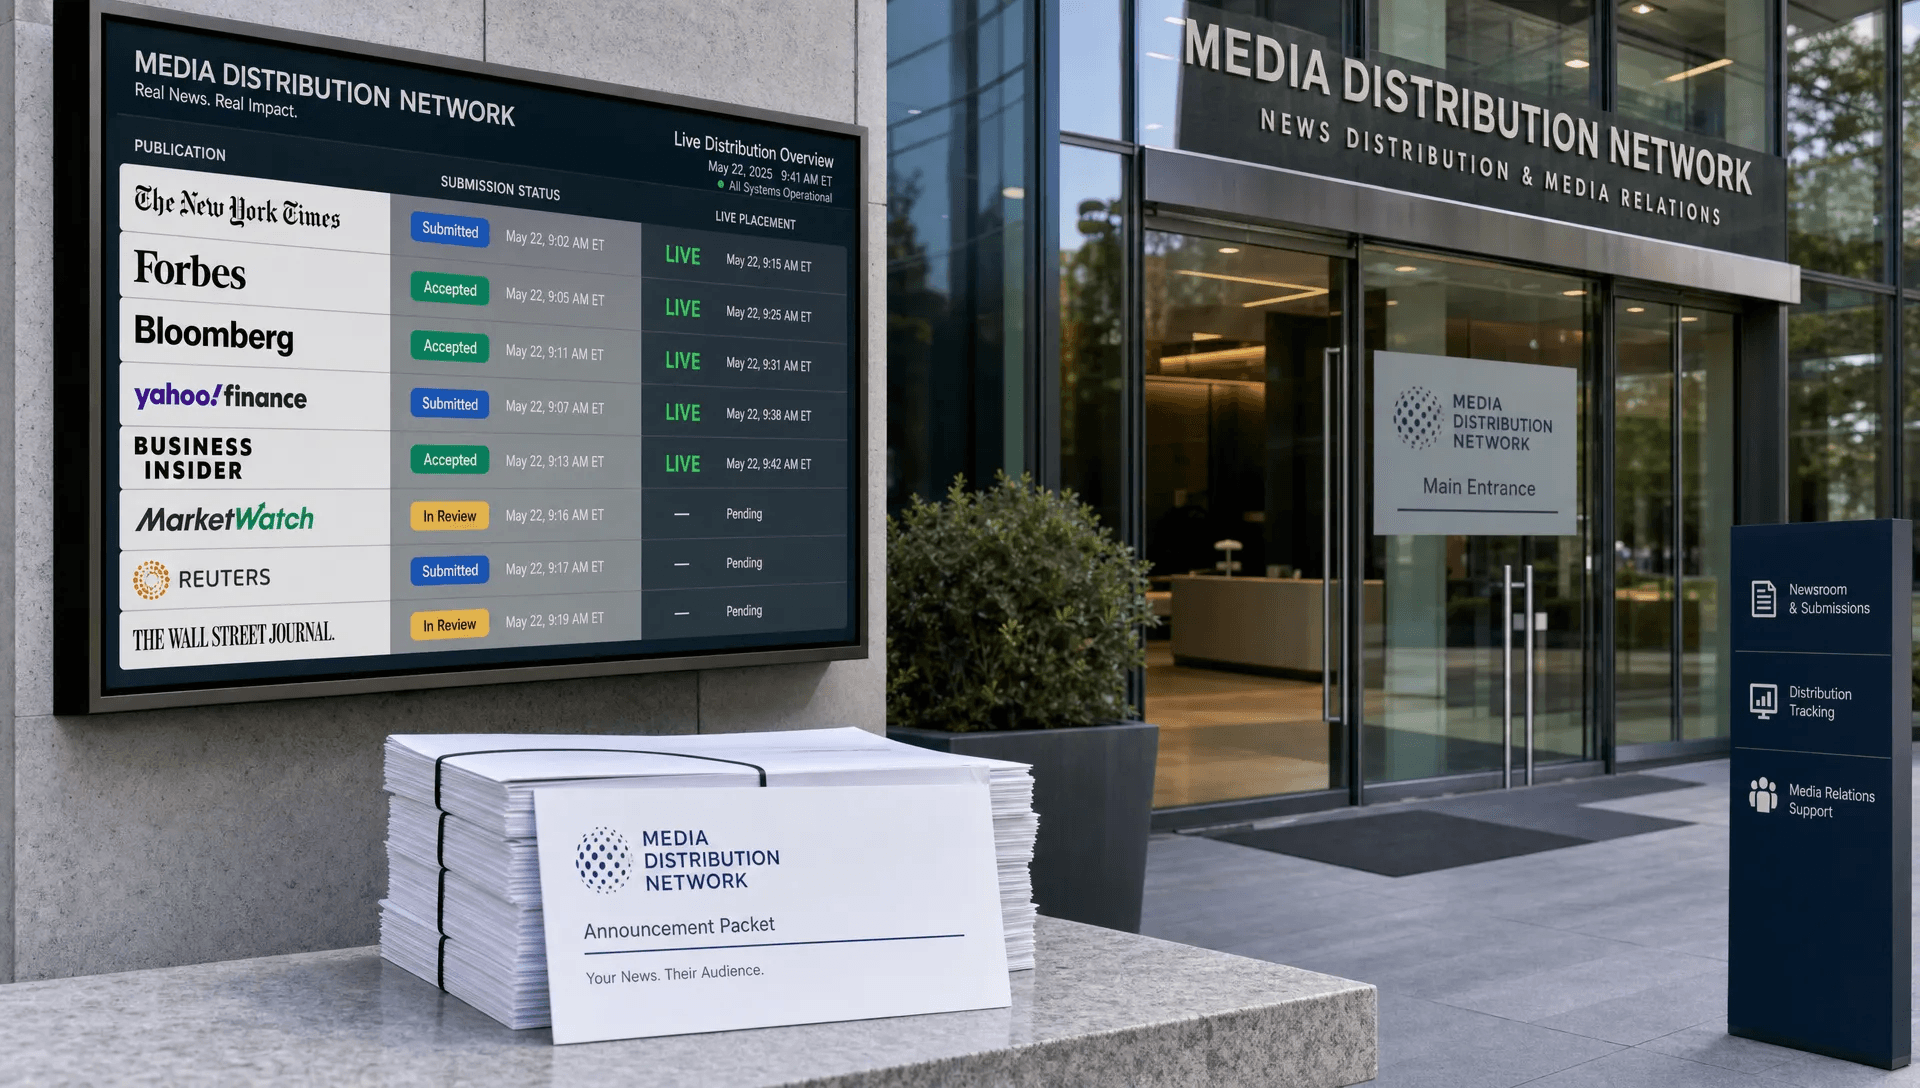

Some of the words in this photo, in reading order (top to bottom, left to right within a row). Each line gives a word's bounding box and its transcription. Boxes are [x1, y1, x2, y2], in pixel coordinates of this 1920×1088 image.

[136, 50, 216, 83] MEDIA
[224, 63, 389, 108] DISTRIBUTION
[401, 90, 515, 126] NETWORK
[136, 82, 164, 99] Real
[170, 87, 210, 105] News.
[216, 94, 243, 110] Real
[249, 98, 297, 118] Impact.
[1184, 17, 1330, 95] MEDIA
[1345, 56, 1598, 158] DISTRIBUTION
[1611, 126, 1752, 195] NETWORK
[135, 139, 225, 161] PUBLICATION
[675, 131, 700, 149] Live
[706, 136, 776, 160] Distribution
[780, 148, 833, 168] Overview
[709, 160, 728, 176] May
[732, 163, 745, 177] 22,
[750, 166, 772, 179] 2025
[781, 170, 799, 182] 9:41
[804, 173, 818, 185] AM
[822, 175, 832, 186] ET
[1262, 108, 1329, 142] NEWS
[1348, 127, 1507, 180] DISTRIBUTION
[1523, 166, 1532, 185] &
[1546, 171, 1609, 202] MEDIA
[1622, 188, 1719, 225] RELATIONS
[441, 176, 513, 195] SUBMISSION
[519, 185, 560, 200] STATUS
[729, 181, 740, 191] All
[744, 182, 780, 196] Systems
[783, 188, 832, 202] Operational
[135, 185, 174, 216] The
[180, 190, 224, 217] New
[229, 196, 278, 224] York
[283, 201, 340, 228] Times
[716, 211, 736, 223] LIVE
[740, 214, 796, 229] PLACEMENT
[422, 221, 479, 240] Submitted
[507, 230, 527, 246] May
[531, 232, 545, 246] 22,
[549, 234, 569, 247] 9:02
[573, 237, 588, 249] AM
[593, 239, 604, 251] ET
[666, 245, 701, 265] LIVE
[727, 254, 745, 268] May
[748, 256, 760, 269] 22,
[763, 257, 781, 269] 9:15
[784, 260, 798, 271] AM
[801, 261, 811, 272] ET
[134, 250, 246, 289] Forbes
[424, 281, 477, 299] Accepted
[507, 287, 527, 303] May
[530, 289, 544, 303] 22,
[549, 291, 569, 303] 9:05
[573, 293, 588, 305] AM
[593, 294, 604, 306] ET
[666, 298, 700, 317] LIVE
[727, 306, 745, 320] May
[748, 307, 760, 320] 22,
[763, 308, 781, 320] 9:25
[784, 310, 798, 321] AM
[801, 311, 811, 322] ET
[135, 315, 293, 357] Bloomberg
[424, 339, 477, 357] Accepted
[507, 344, 527, 359] May
[531, 345, 544, 359] 22,
[549, 346, 567, 358] 9:11
[572, 348, 587, 359] AM
[592, 349, 604, 360] ET
[666, 351, 700, 369] LIVE
[727, 357, 745, 371] May
[748, 358, 760, 371] 22,
[763, 359, 780, 370] 9:31
[784, 360, 798, 371] AM
[801, 361, 811, 372] ET
[422, 397, 478, 410] Submitted
[507, 400, 527, 415] May
[531, 401, 545, 414] 22,
[549, 401, 569, 413] 9:07
[572, 402, 588, 413] AM
[592, 403, 604, 414] ET
[1454, 394, 1502, 411] MEDIA
[666, 403, 700, 421] LIVE
[727, 408, 744, 422] May
[748, 409, 760, 421] 22,
[763, 409, 781, 420] 9:38
[784, 410, 798, 420] AM
[801, 410, 811, 421] ET
[1454, 414, 1552, 433] DISTRIBUTION
[135, 437, 251, 456] BUSINESS
[1454, 434, 1529, 450] NETWORK
[146, 461, 241, 479] INSIDER
[424, 453, 476, 469] Accepted
[507, 455, 527, 470] May
[530, 455, 545, 468] 22,
[549, 455, 568, 467] 9:13
[572, 456, 588, 467] AM
[592, 456, 604, 467] ET
[666, 455, 700, 472] LIVE
[727, 458, 745, 471] May
[748, 458, 760, 470] 22,
[763, 458, 781, 469] 9:42
[784, 459, 798, 469] AM
[801, 459, 811, 469] ET
[1424, 478, 1461, 494] Main
[1468, 479, 1535, 496] Entrance
[135, 502, 313, 531] MarketWatch
[424, 510, 433, 522] In
[438, 510, 476, 521] Review
[507, 510, 527, 524] May
[530, 509, 545, 523] 22,
[548, 509, 568, 520] 9:16
[572, 509, 588, 520] AM
[592, 509, 604, 520] ET
[727, 508, 762, 521] Pending
[423, 563, 478, 577] Submitted
[507, 563, 527, 577] May
[531, 562, 545, 575] 22,
[549, 562, 568, 573] 9:17
[572, 561, 588, 573] AM
[592, 561, 604, 572] ET
[727, 557, 762, 570] Pending
[180, 569, 270, 588] REUTERS
[1790, 584, 1847, 595] Newsroom
[727, 605, 762, 618] Pending
[1790, 602, 1797, 614] &
[1802, 602, 1870, 614] Submissions
[424, 620, 433, 632] In
[438, 619, 476, 631] Review
[506, 616, 527, 630] May
[530, 615, 545, 628] 22,
[549, 614, 569, 625] 9:19
[572, 613, 588, 624] AM
[592, 612, 604, 623] ET
[133, 629, 164, 650] THE
[169, 627, 208, 648] WALL
[212, 624, 266, 646] STREET
[269, 621, 334, 643] JOURNAL.
[1790, 686, 1851, 700] Distribution
[1790, 704, 1834, 721] Tracking
[1790, 784, 1821, 798] Media
[1826, 787, 1875, 802] Relations
[1790, 802, 1832, 819] Support
[643, 830, 708, 846] MEDIA
[645, 850, 779, 868] DISTRIBUTION
[646, 873, 747, 891] NETWORK
[584, 920, 714, 939] Announcement
[721, 917, 775, 933] Packet
[586, 973, 616, 984] Your
[622, 971, 660, 982] News.
[665, 967, 697, 980] Their
[702, 965, 764, 978] Audience.
